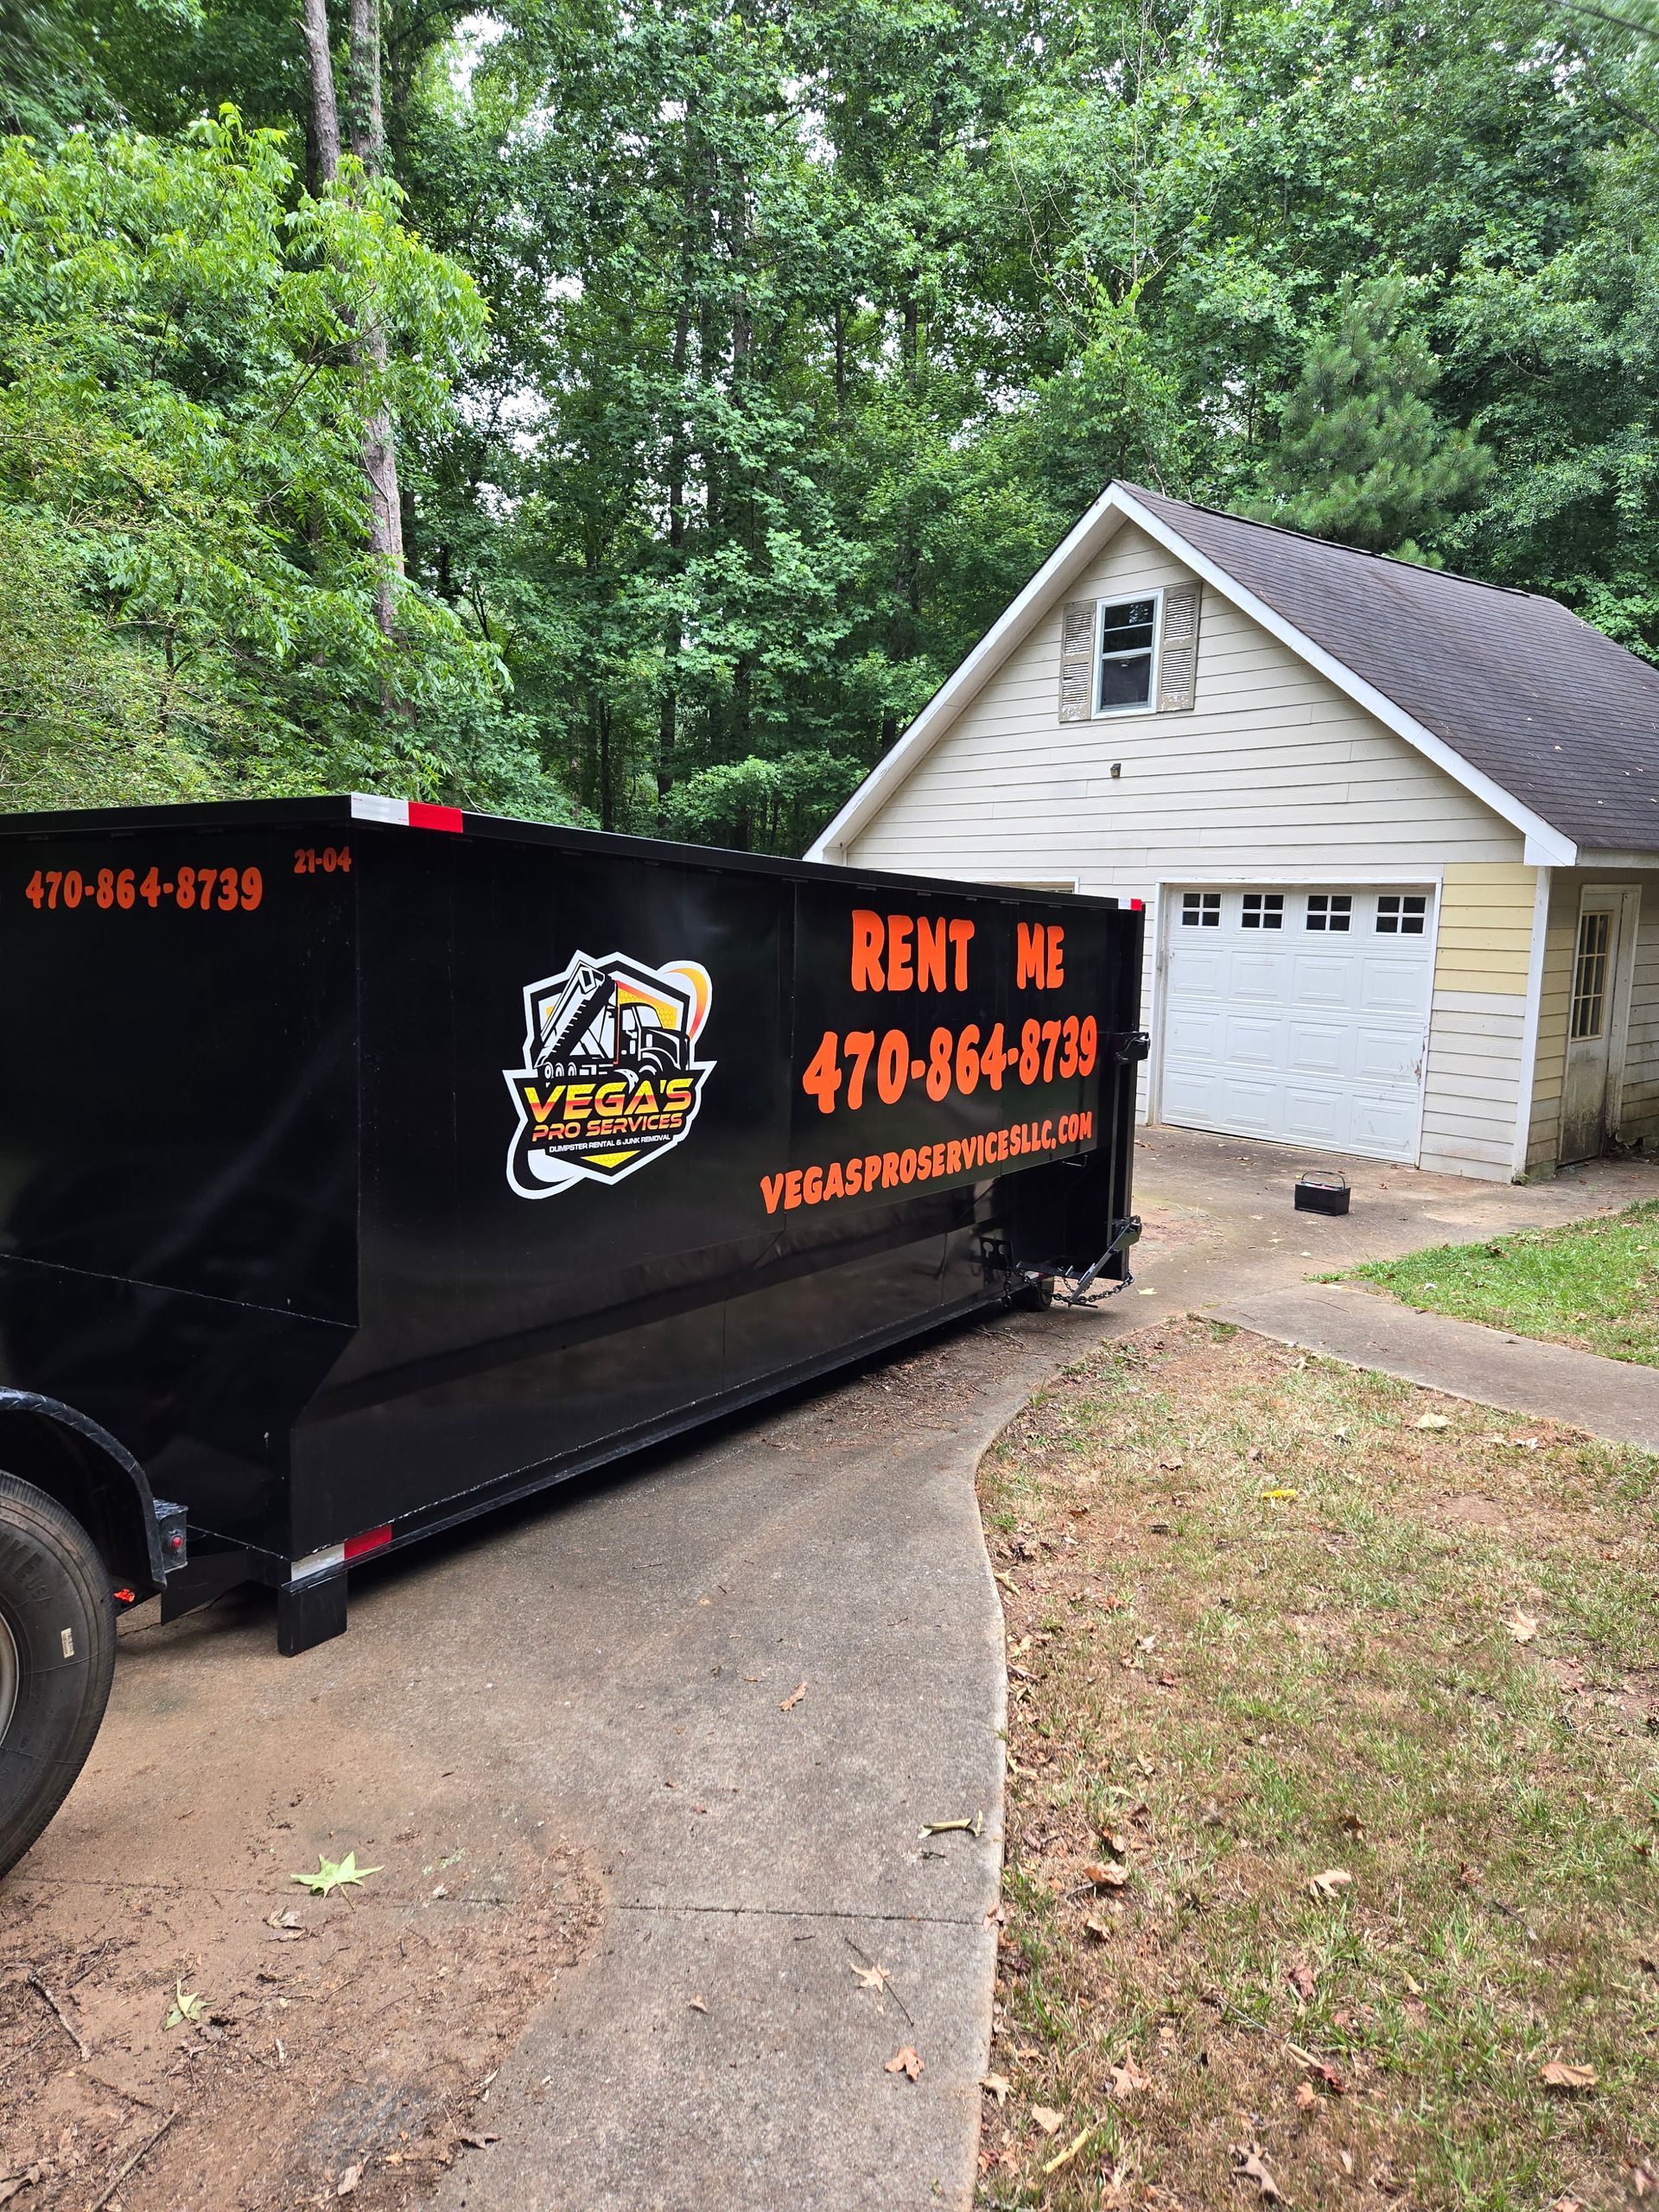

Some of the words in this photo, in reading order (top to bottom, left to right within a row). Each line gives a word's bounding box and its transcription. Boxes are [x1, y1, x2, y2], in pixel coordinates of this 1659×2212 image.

[294, 846, 353, 874] 21-04
[25, 866, 263, 912] 470-864-8739
[850, 909, 976, 993] RENT
[1016, 922, 1065, 990] ME
[802, 1014, 1097, 1115] 470-864-8739
[524, 1077, 695, 1123] VEGA'S
[531, 1122, 581, 1142] PRO
[585, 1112, 683, 1138] SERVICES
[549, 1141, 588, 1154] DUMPSTER
[588, 1139, 615, 1149] RENTAL
[622, 1136, 640, 1145] JUNK
[640, 1133, 671, 1143] REMOVAL
